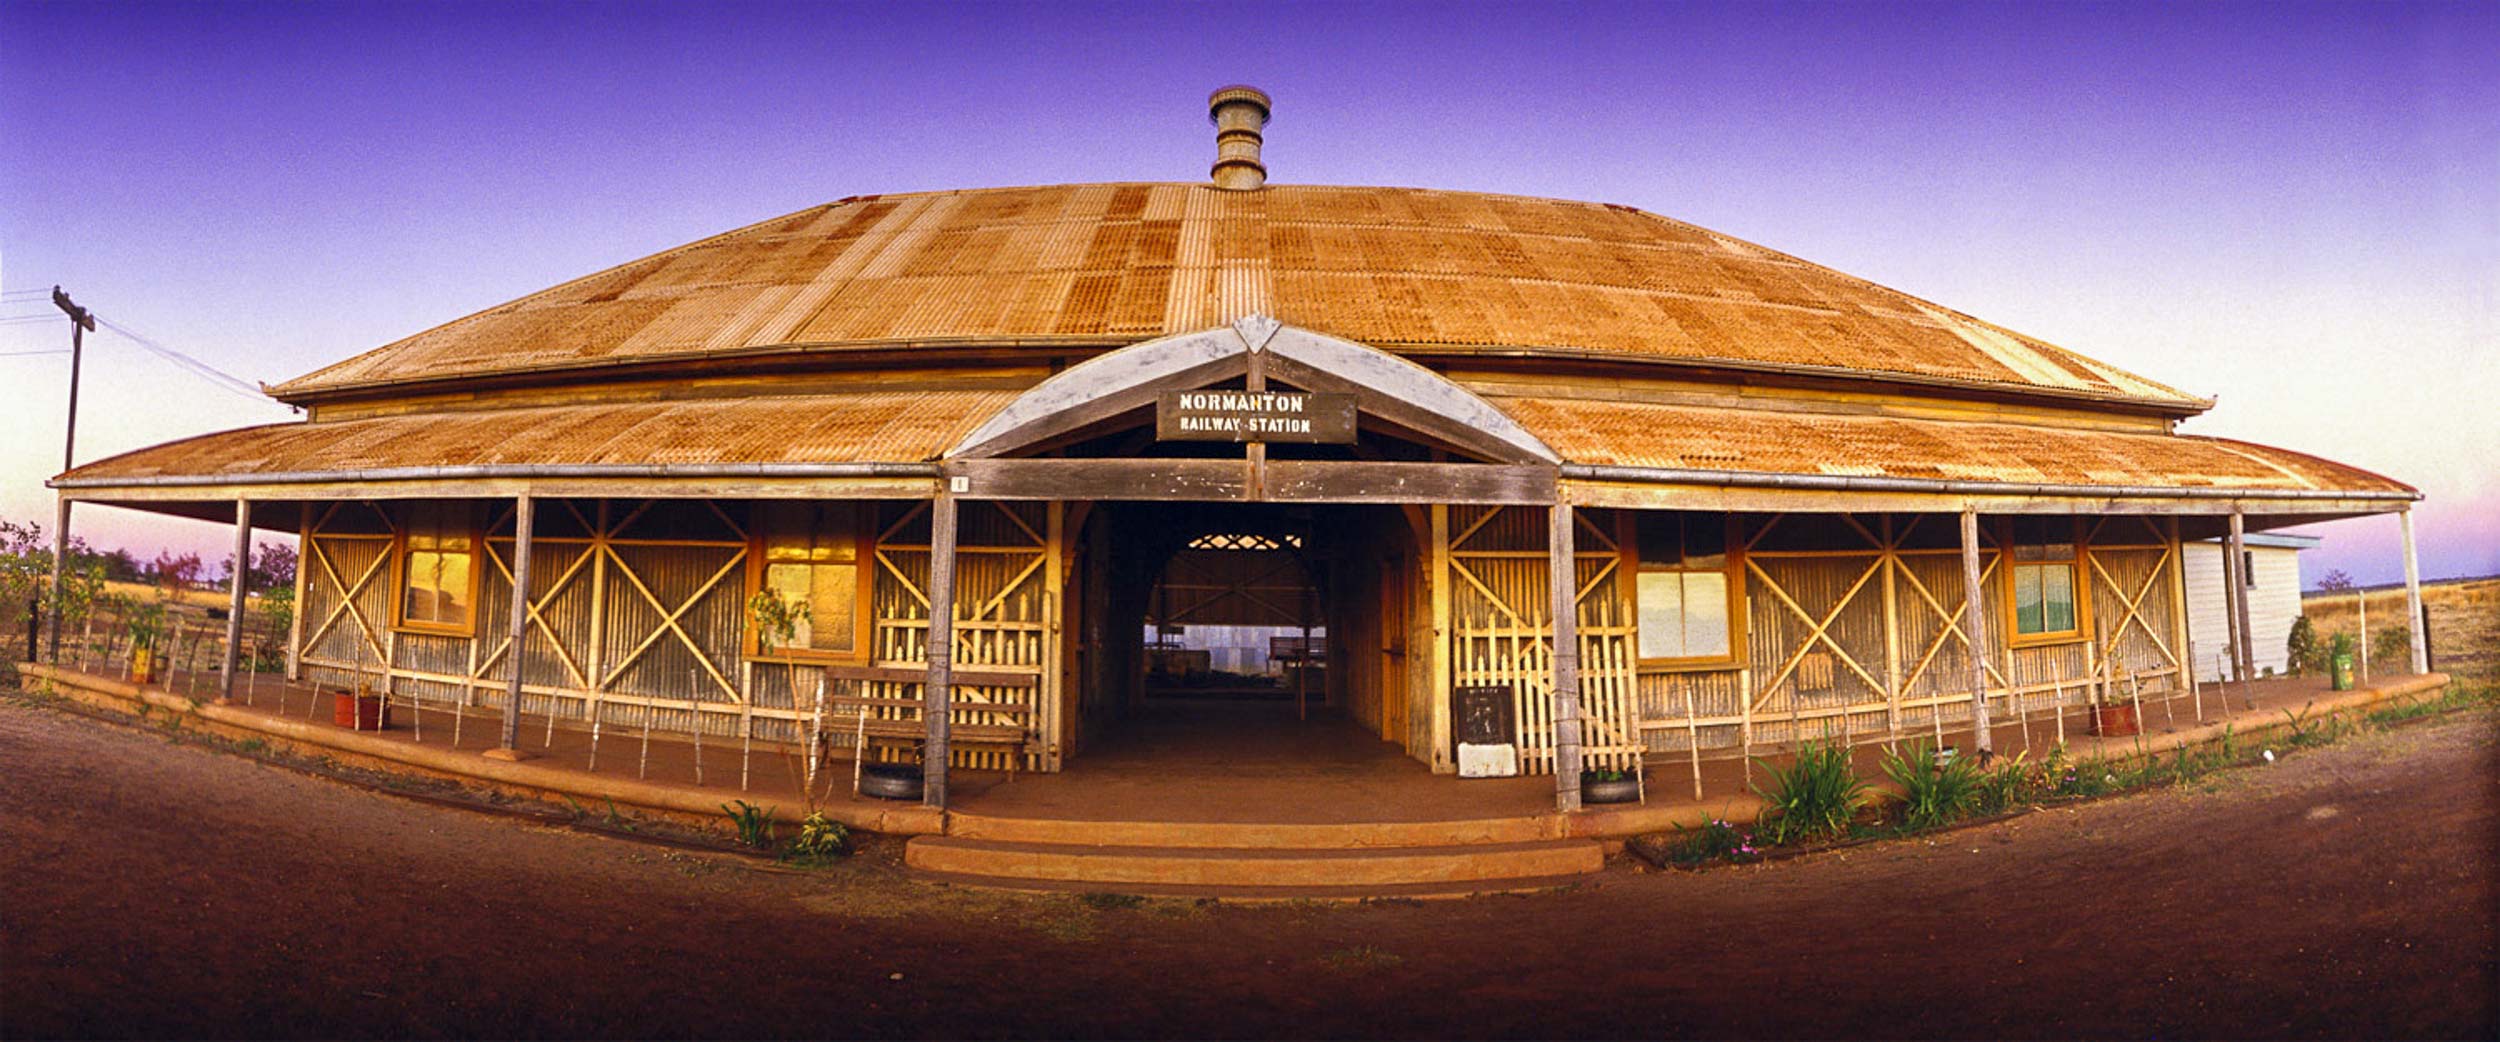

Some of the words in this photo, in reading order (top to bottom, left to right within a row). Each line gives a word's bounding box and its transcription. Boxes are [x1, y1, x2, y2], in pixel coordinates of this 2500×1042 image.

[1179, 393, 1303, 412] NORMANTON
[1180, 416, 1240, 431] RAILWAY
[1249, 419, 1311, 433] STATION
